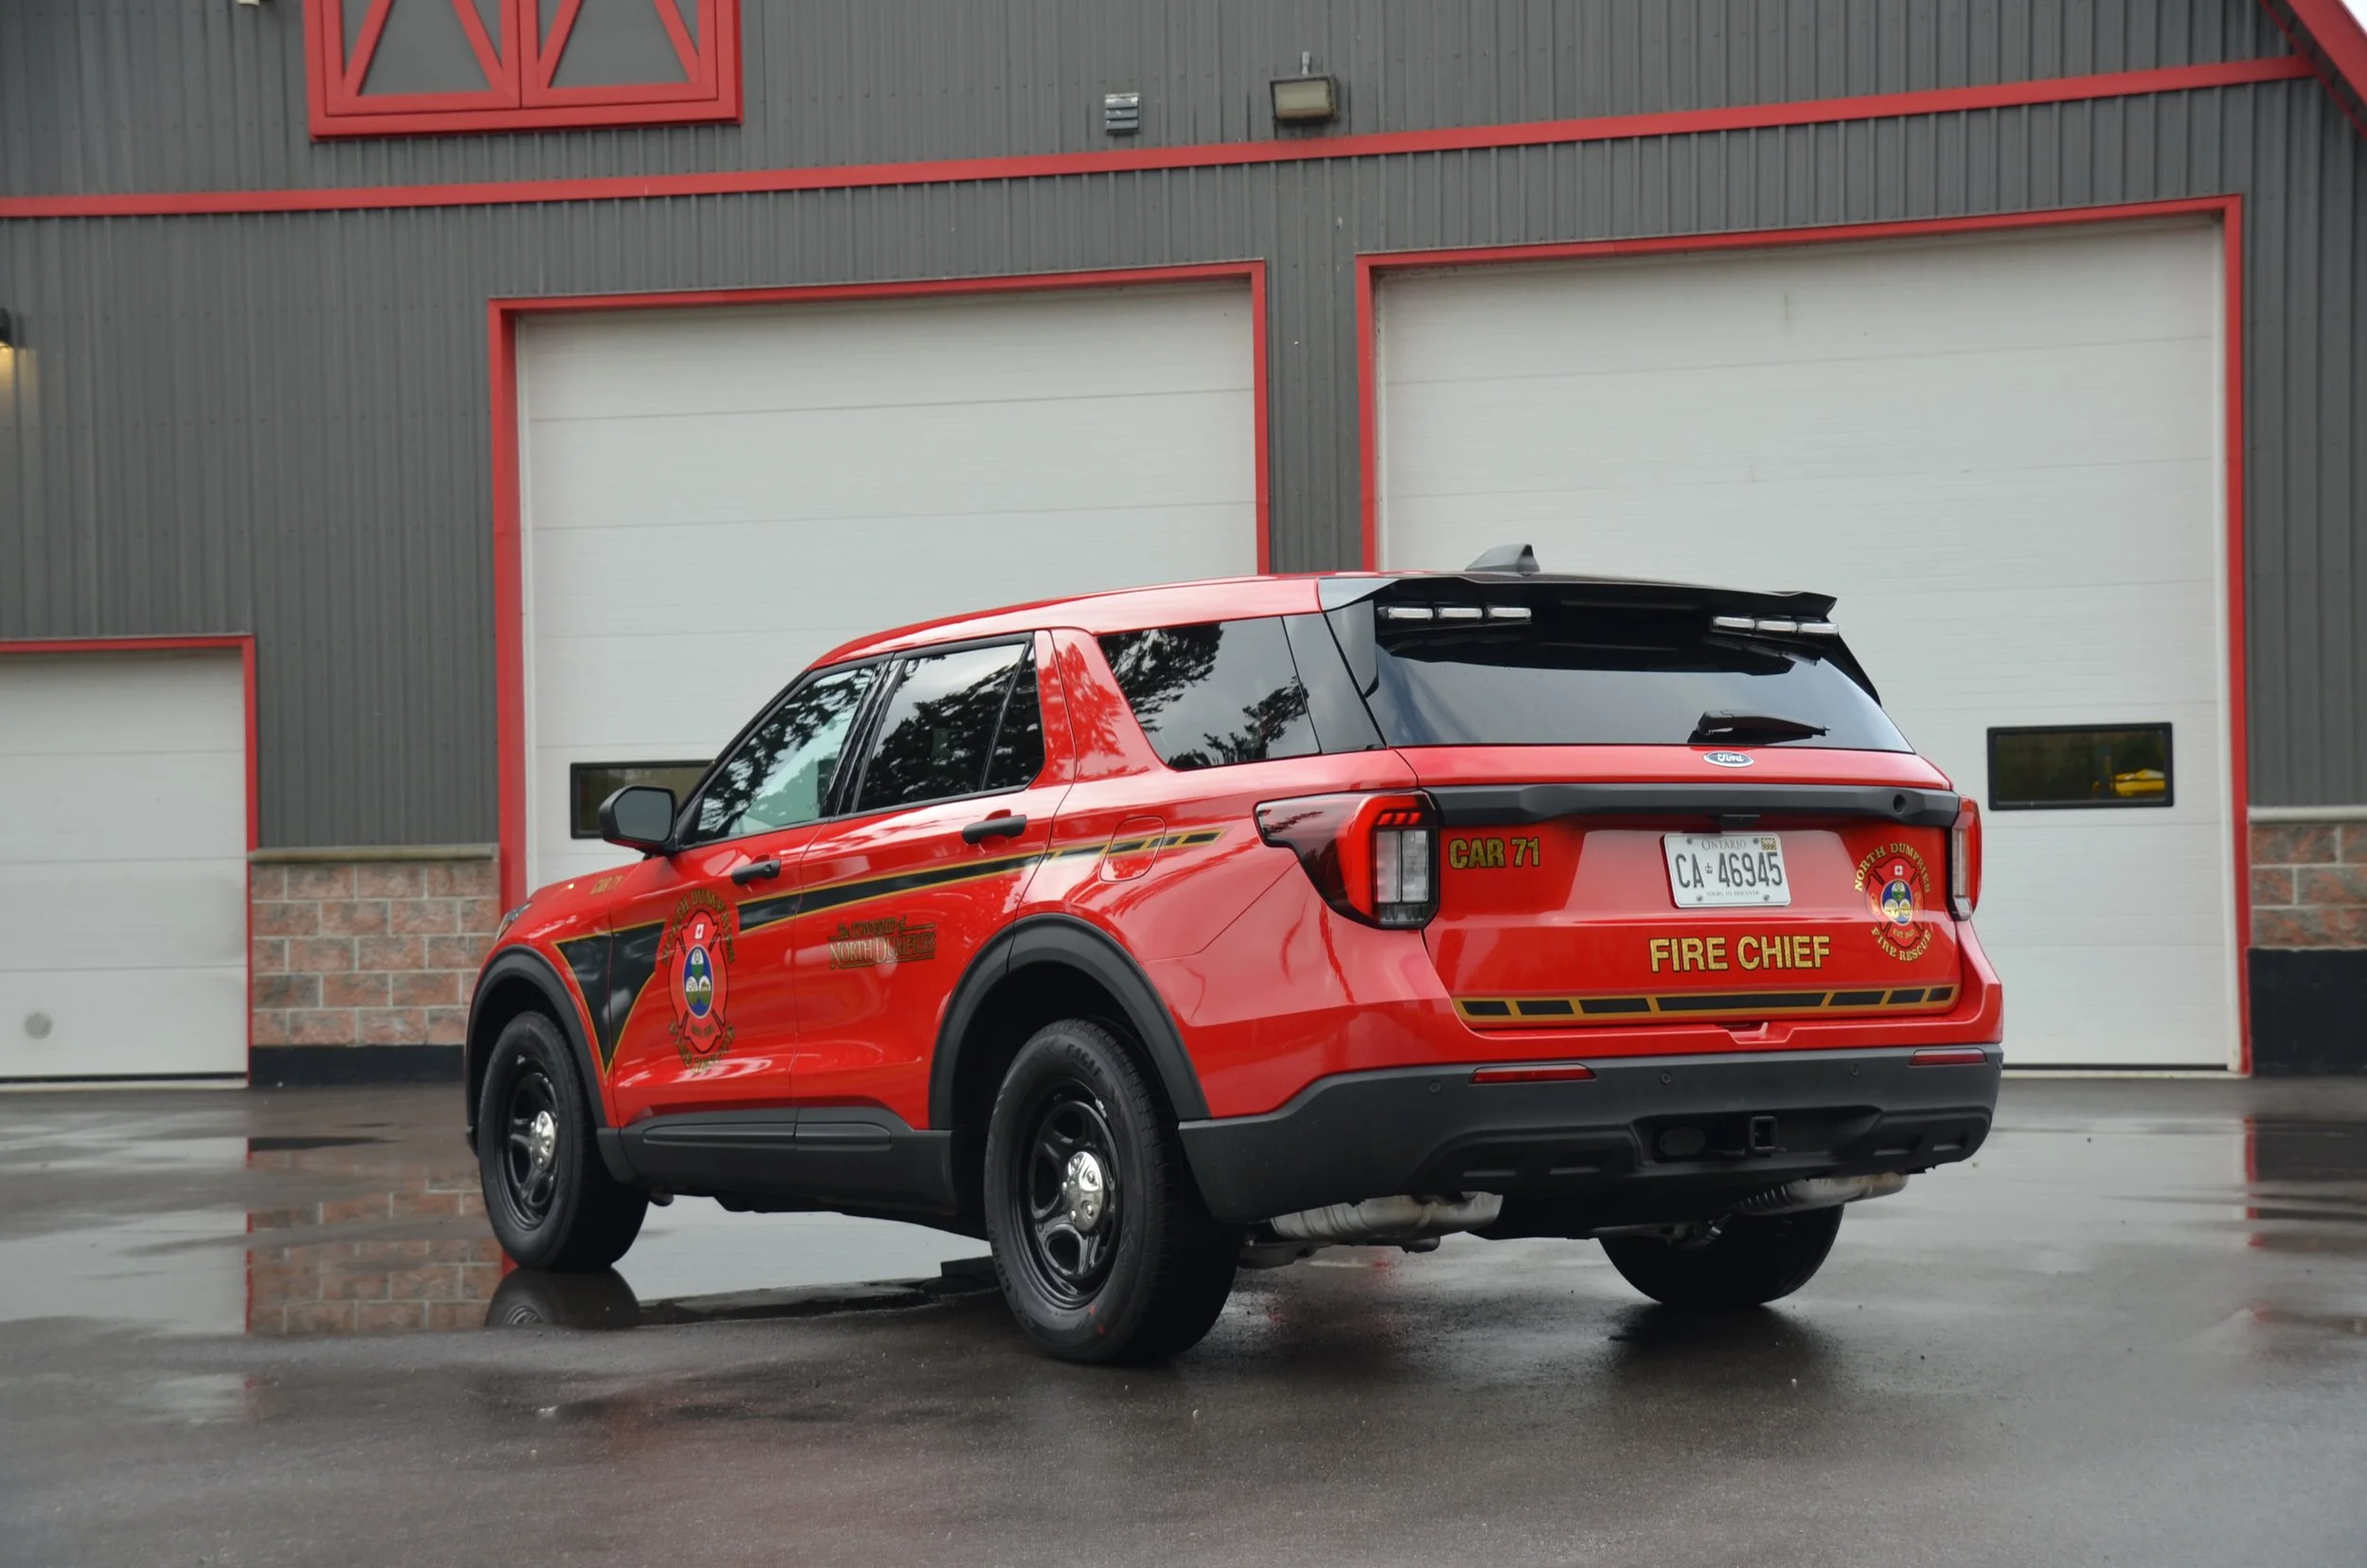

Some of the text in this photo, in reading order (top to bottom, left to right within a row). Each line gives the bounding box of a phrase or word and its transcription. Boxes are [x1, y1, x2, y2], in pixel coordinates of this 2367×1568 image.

[1449, 836, 1540, 869] CAR 71
[1700, 839, 1747, 850] ONTARIO
[1675, 852, 1784, 888] CA 46945
[1854, 843, 1931, 893] NORTH DUMFRIES
[829, 937, 874, 967] NORTH
[1649, 935, 1830, 972] FIRE CHIEF
[1871, 926, 1932, 961] FIRE RESCUE
